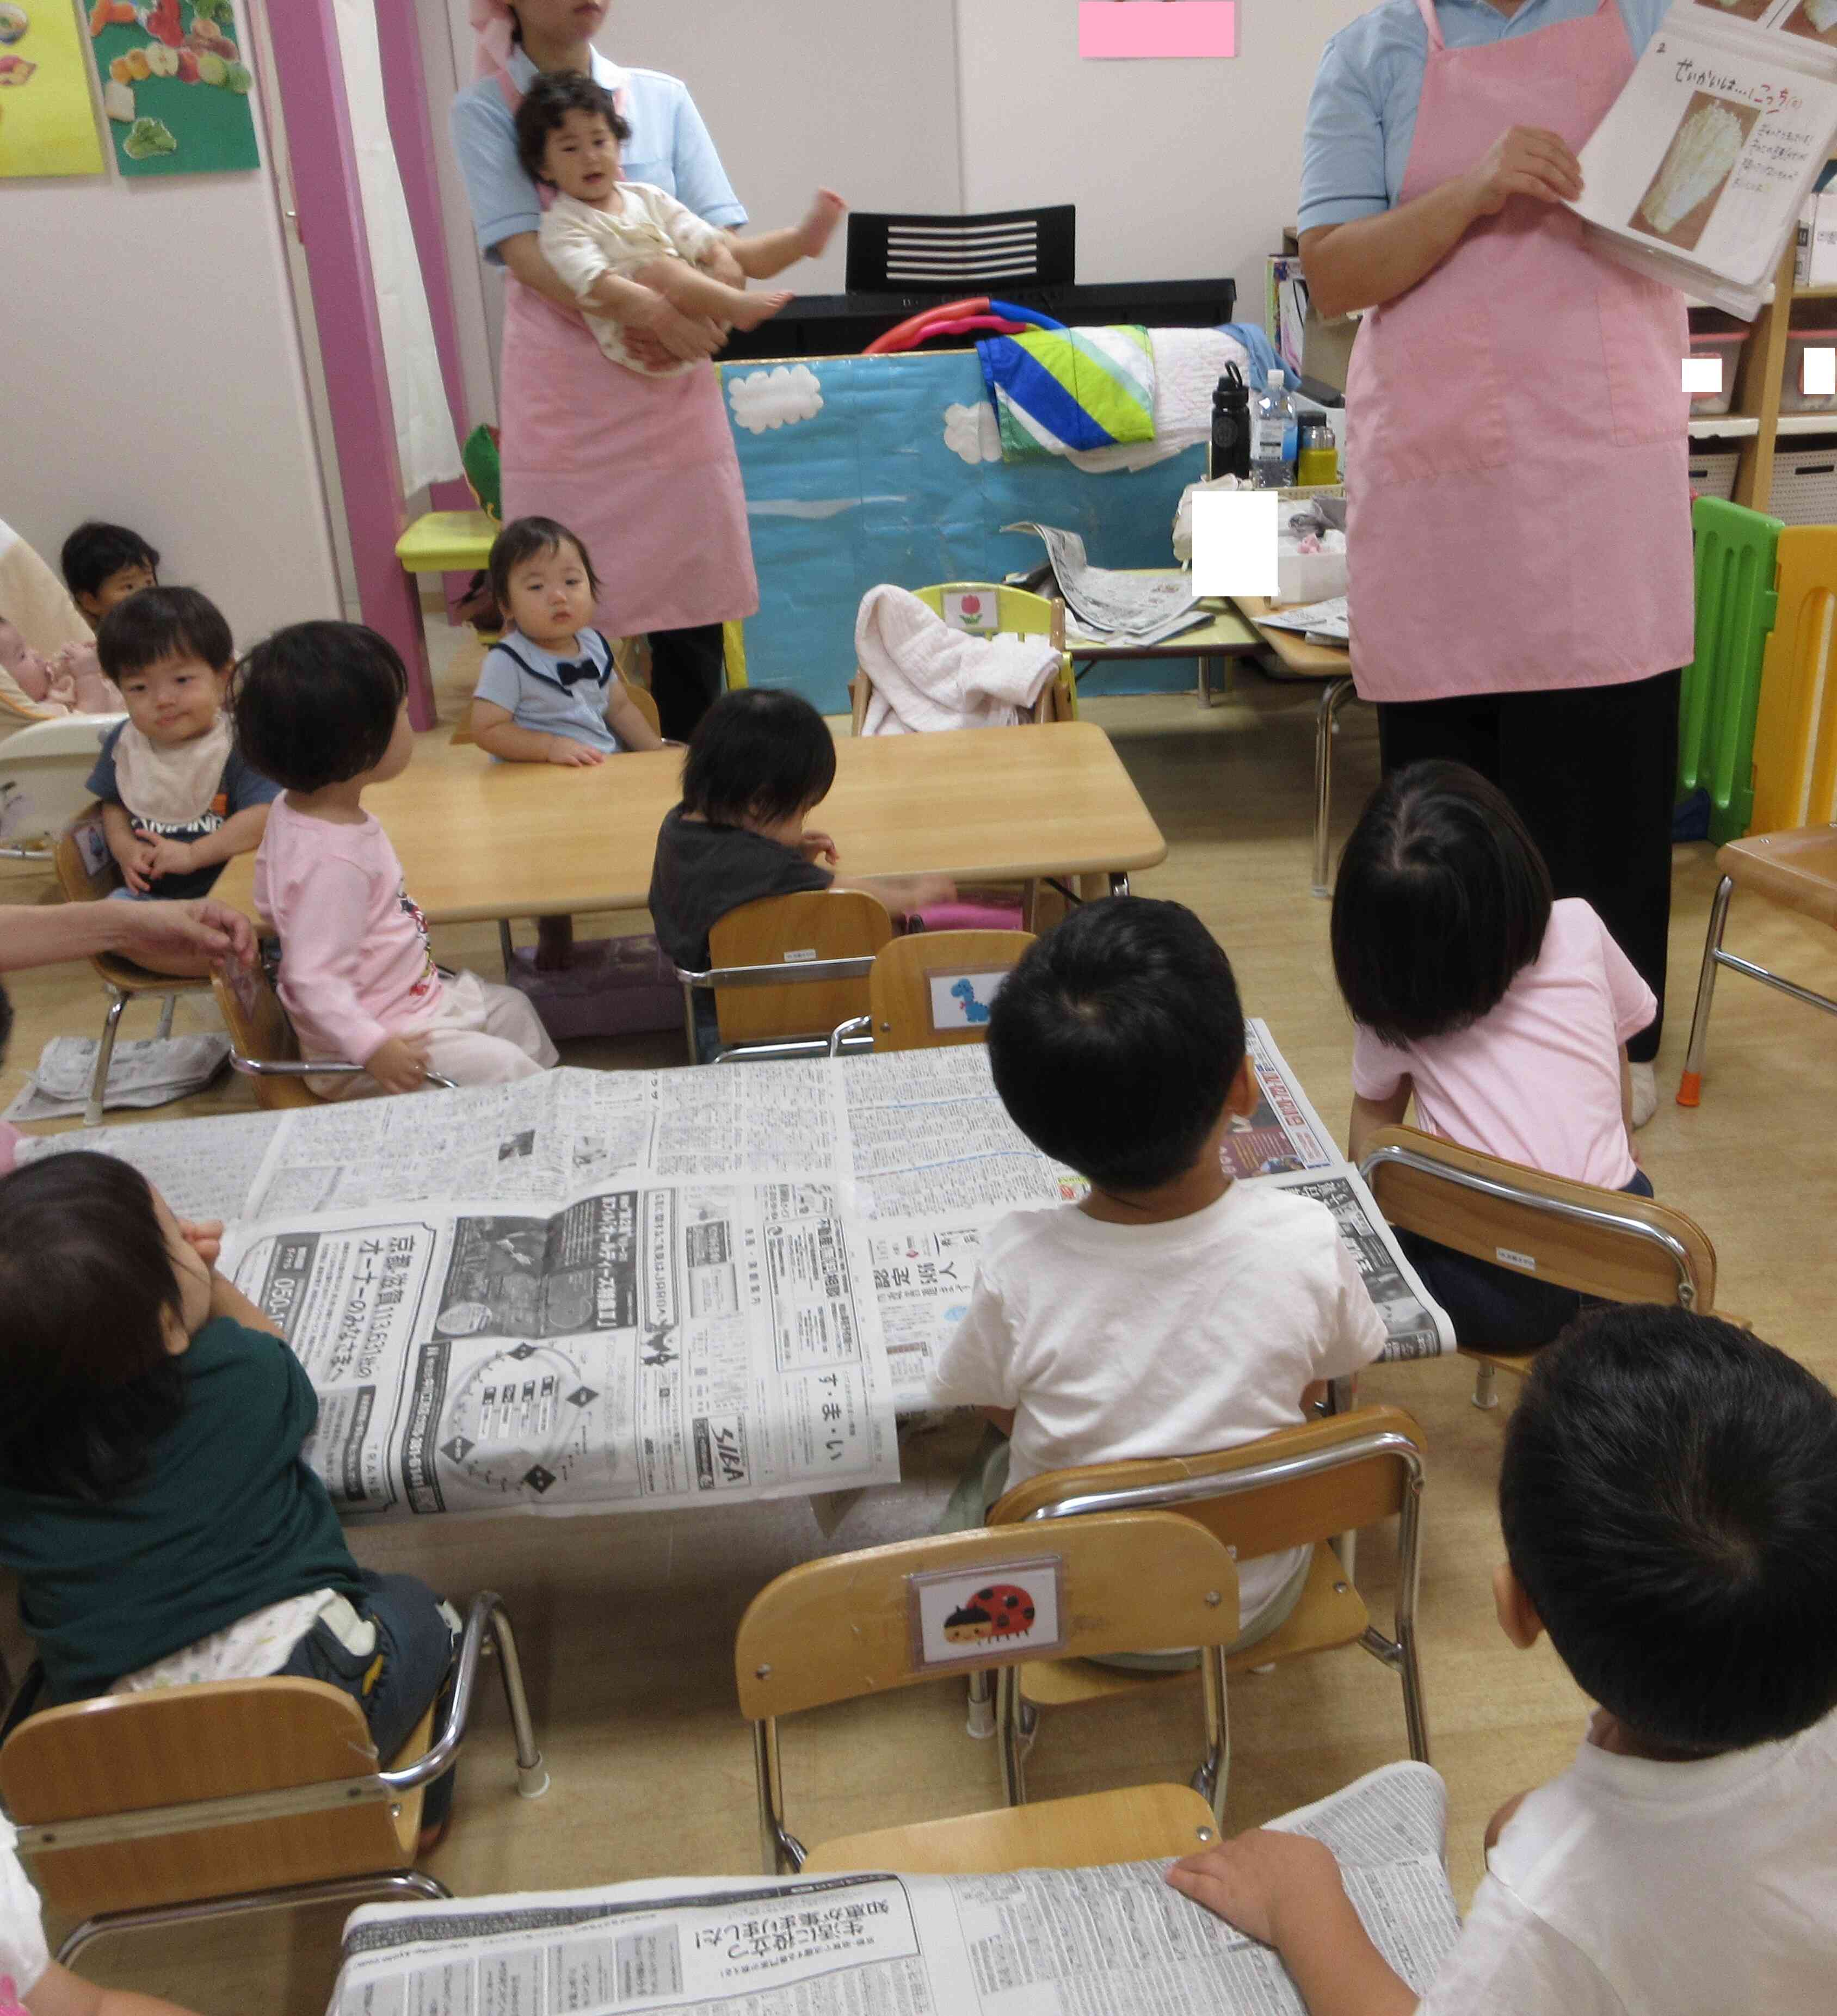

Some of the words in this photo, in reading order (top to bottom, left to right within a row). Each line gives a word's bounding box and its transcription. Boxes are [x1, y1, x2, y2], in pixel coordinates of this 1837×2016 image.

[1656, 42, 1666, 53] 2
[727, 1919, 864, 1959] 生活に役立つ
